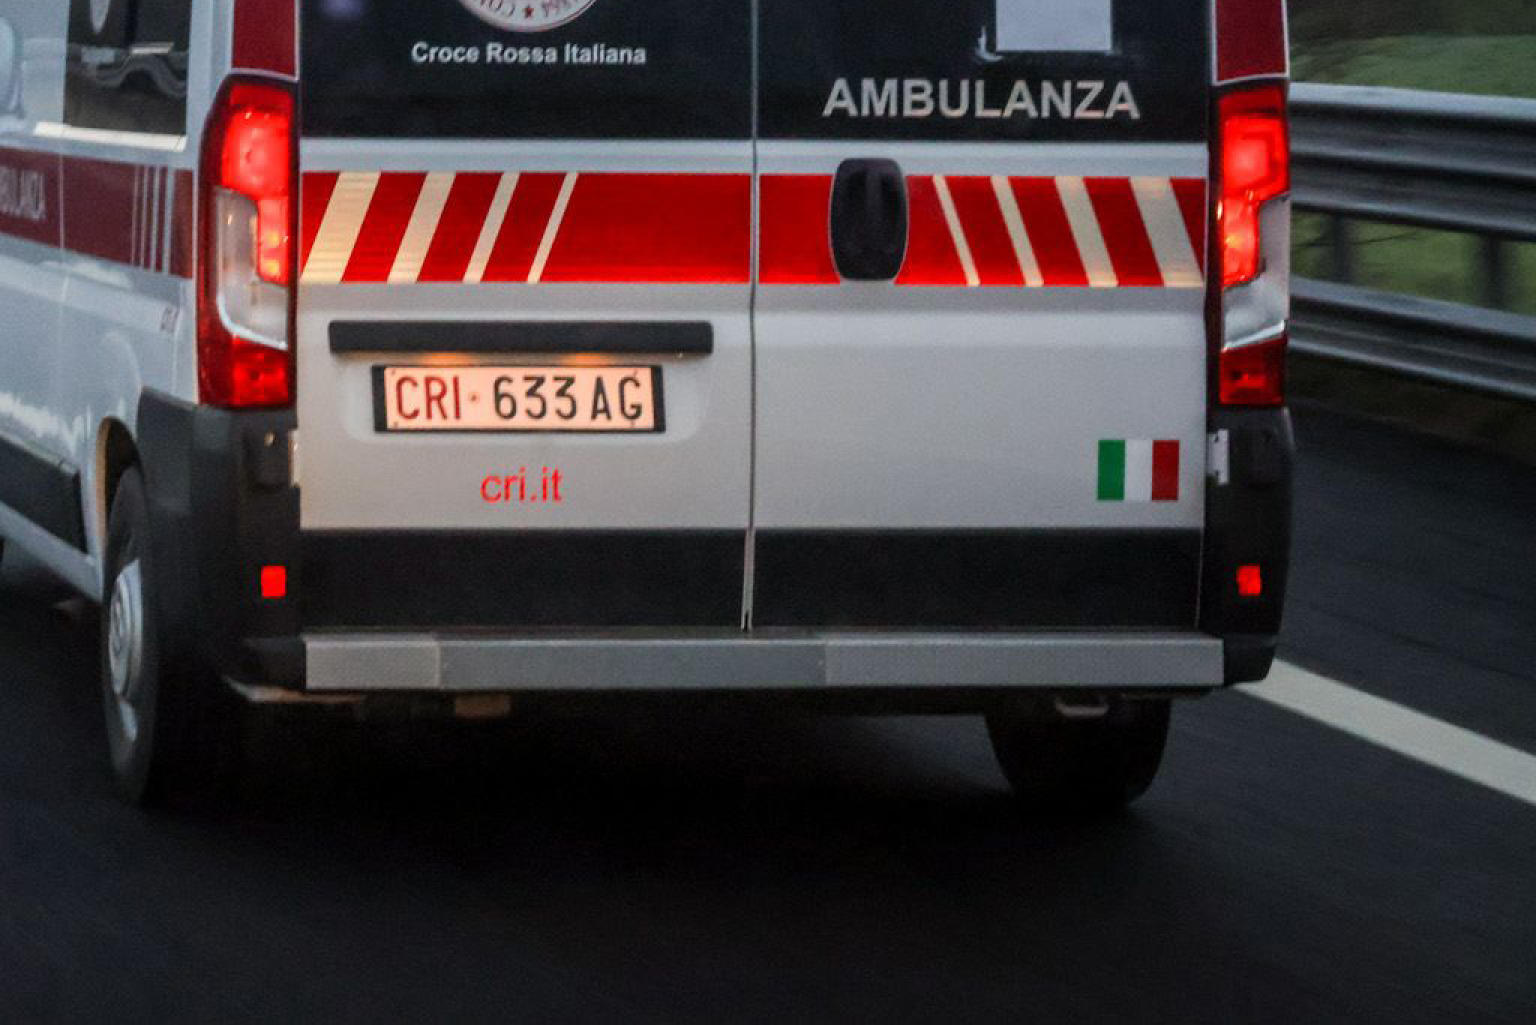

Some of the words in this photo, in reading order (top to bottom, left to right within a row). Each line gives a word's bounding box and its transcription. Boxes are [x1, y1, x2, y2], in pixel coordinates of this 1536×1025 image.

[412, 41, 480, 63] Croce
[486, 42, 558, 64] Rossa
[564, 42, 647, 65] Italiana
[821, 77, 1141, 120] AMBULANZA
[395, 375, 462, 420] CRI
[493, 375, 577, 420] 633
[590, 375, 643, 420] AG
[480, 466, 563, 503] cri.it
